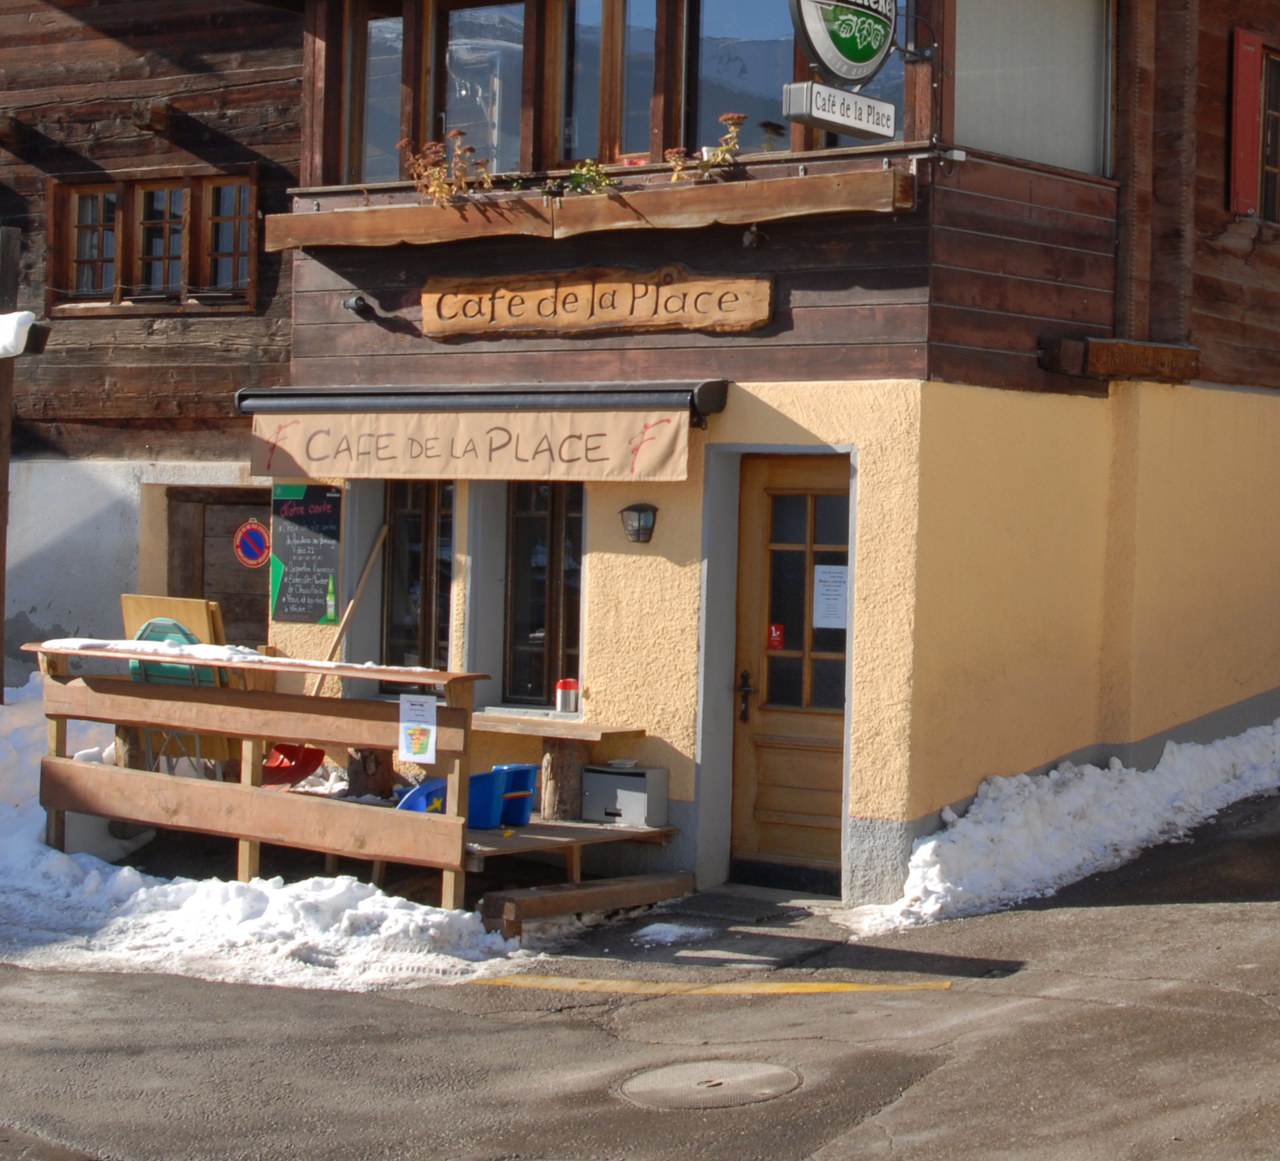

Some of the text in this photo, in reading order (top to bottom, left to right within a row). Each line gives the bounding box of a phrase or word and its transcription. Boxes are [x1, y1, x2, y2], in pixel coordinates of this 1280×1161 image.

[815, 91, 891, 129] Café de la Place
[537, 280, 579, 318] de
[588, 280, 618, 319] la
[629, 281, 740, 317] Place
[305, 426, 610, 463] CAFE DE LA PLACE
